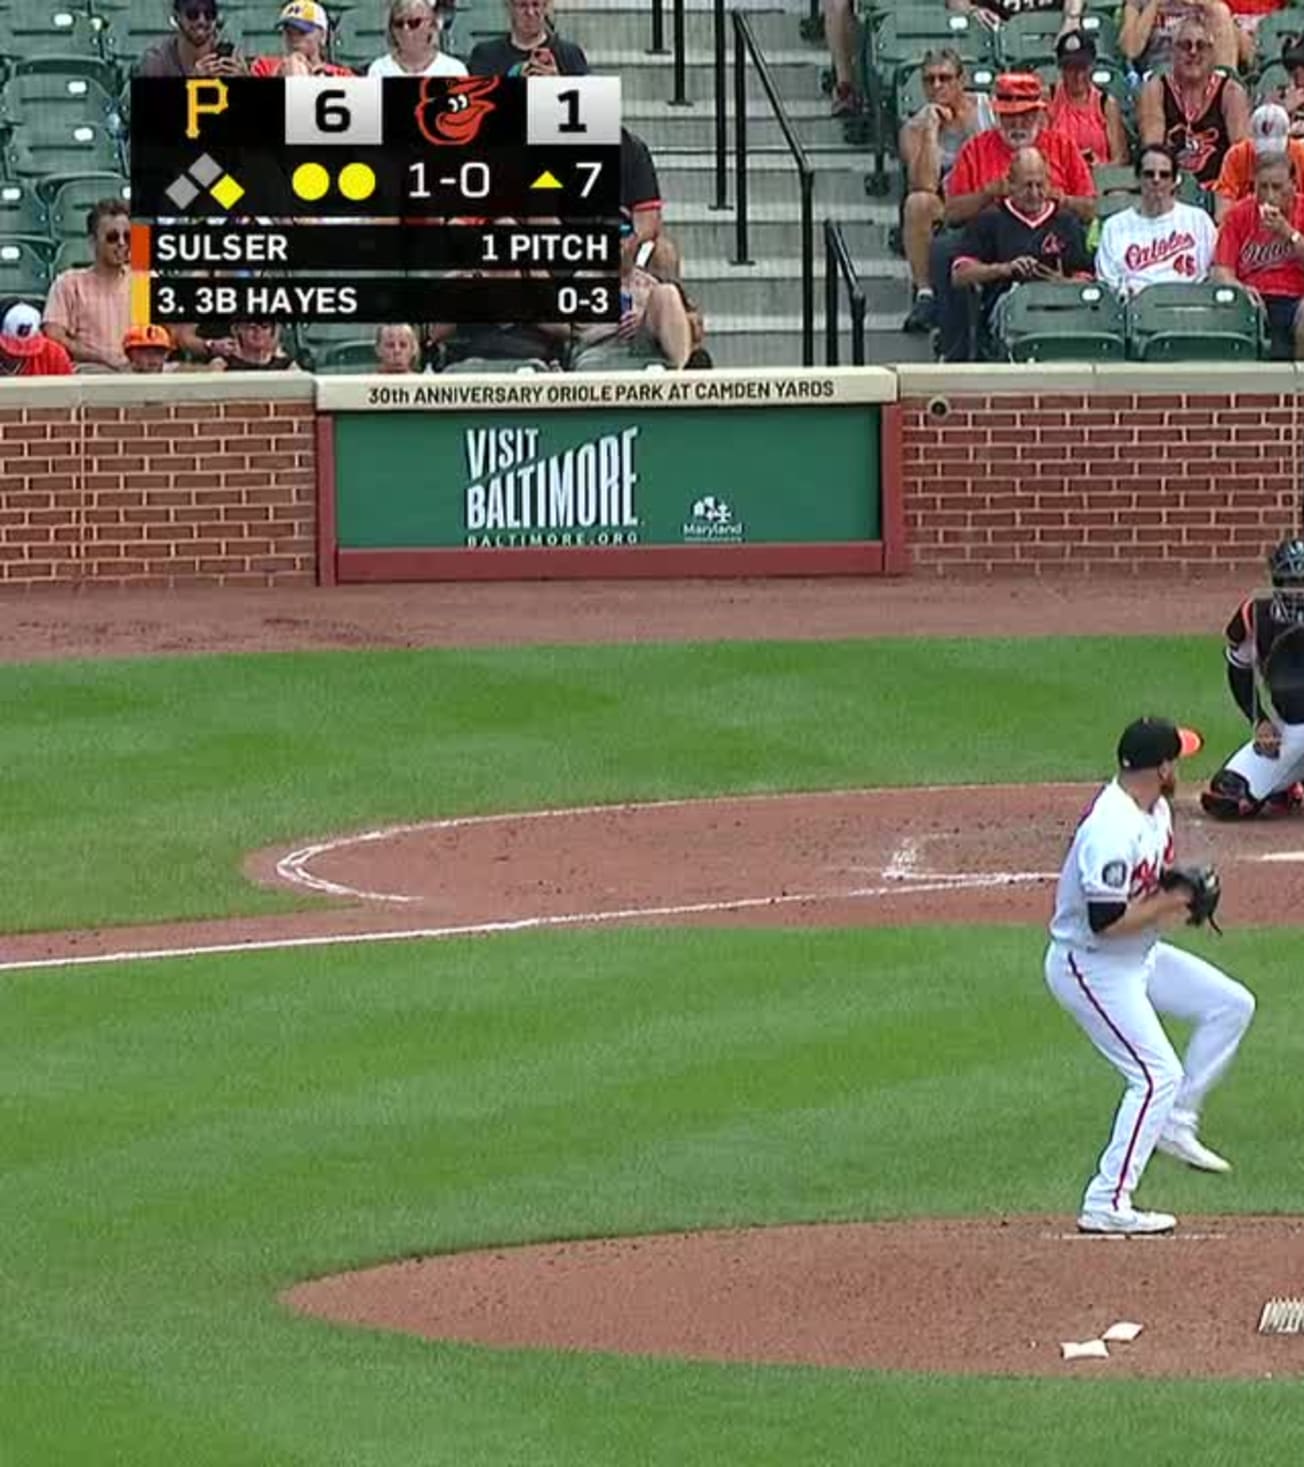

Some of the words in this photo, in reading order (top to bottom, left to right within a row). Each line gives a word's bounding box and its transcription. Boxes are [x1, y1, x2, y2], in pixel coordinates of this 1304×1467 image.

[368, 387, 409, 405] 30th
[414, 385, 544, 404] ANNIVERSARY
[546, 385, 611, 402] ORIOLE
[615, 384, 663, 401] PARK
[668, 383, 691, 400] AT
[695, 381, 770, 399] CAMDEN
[775, 380, 834, 398] YARDS
[466, 428, 539, 481] VISIT
[467, 426, 638, 529] BALTIMORE
[683, 522, 742, 538] Maryland
